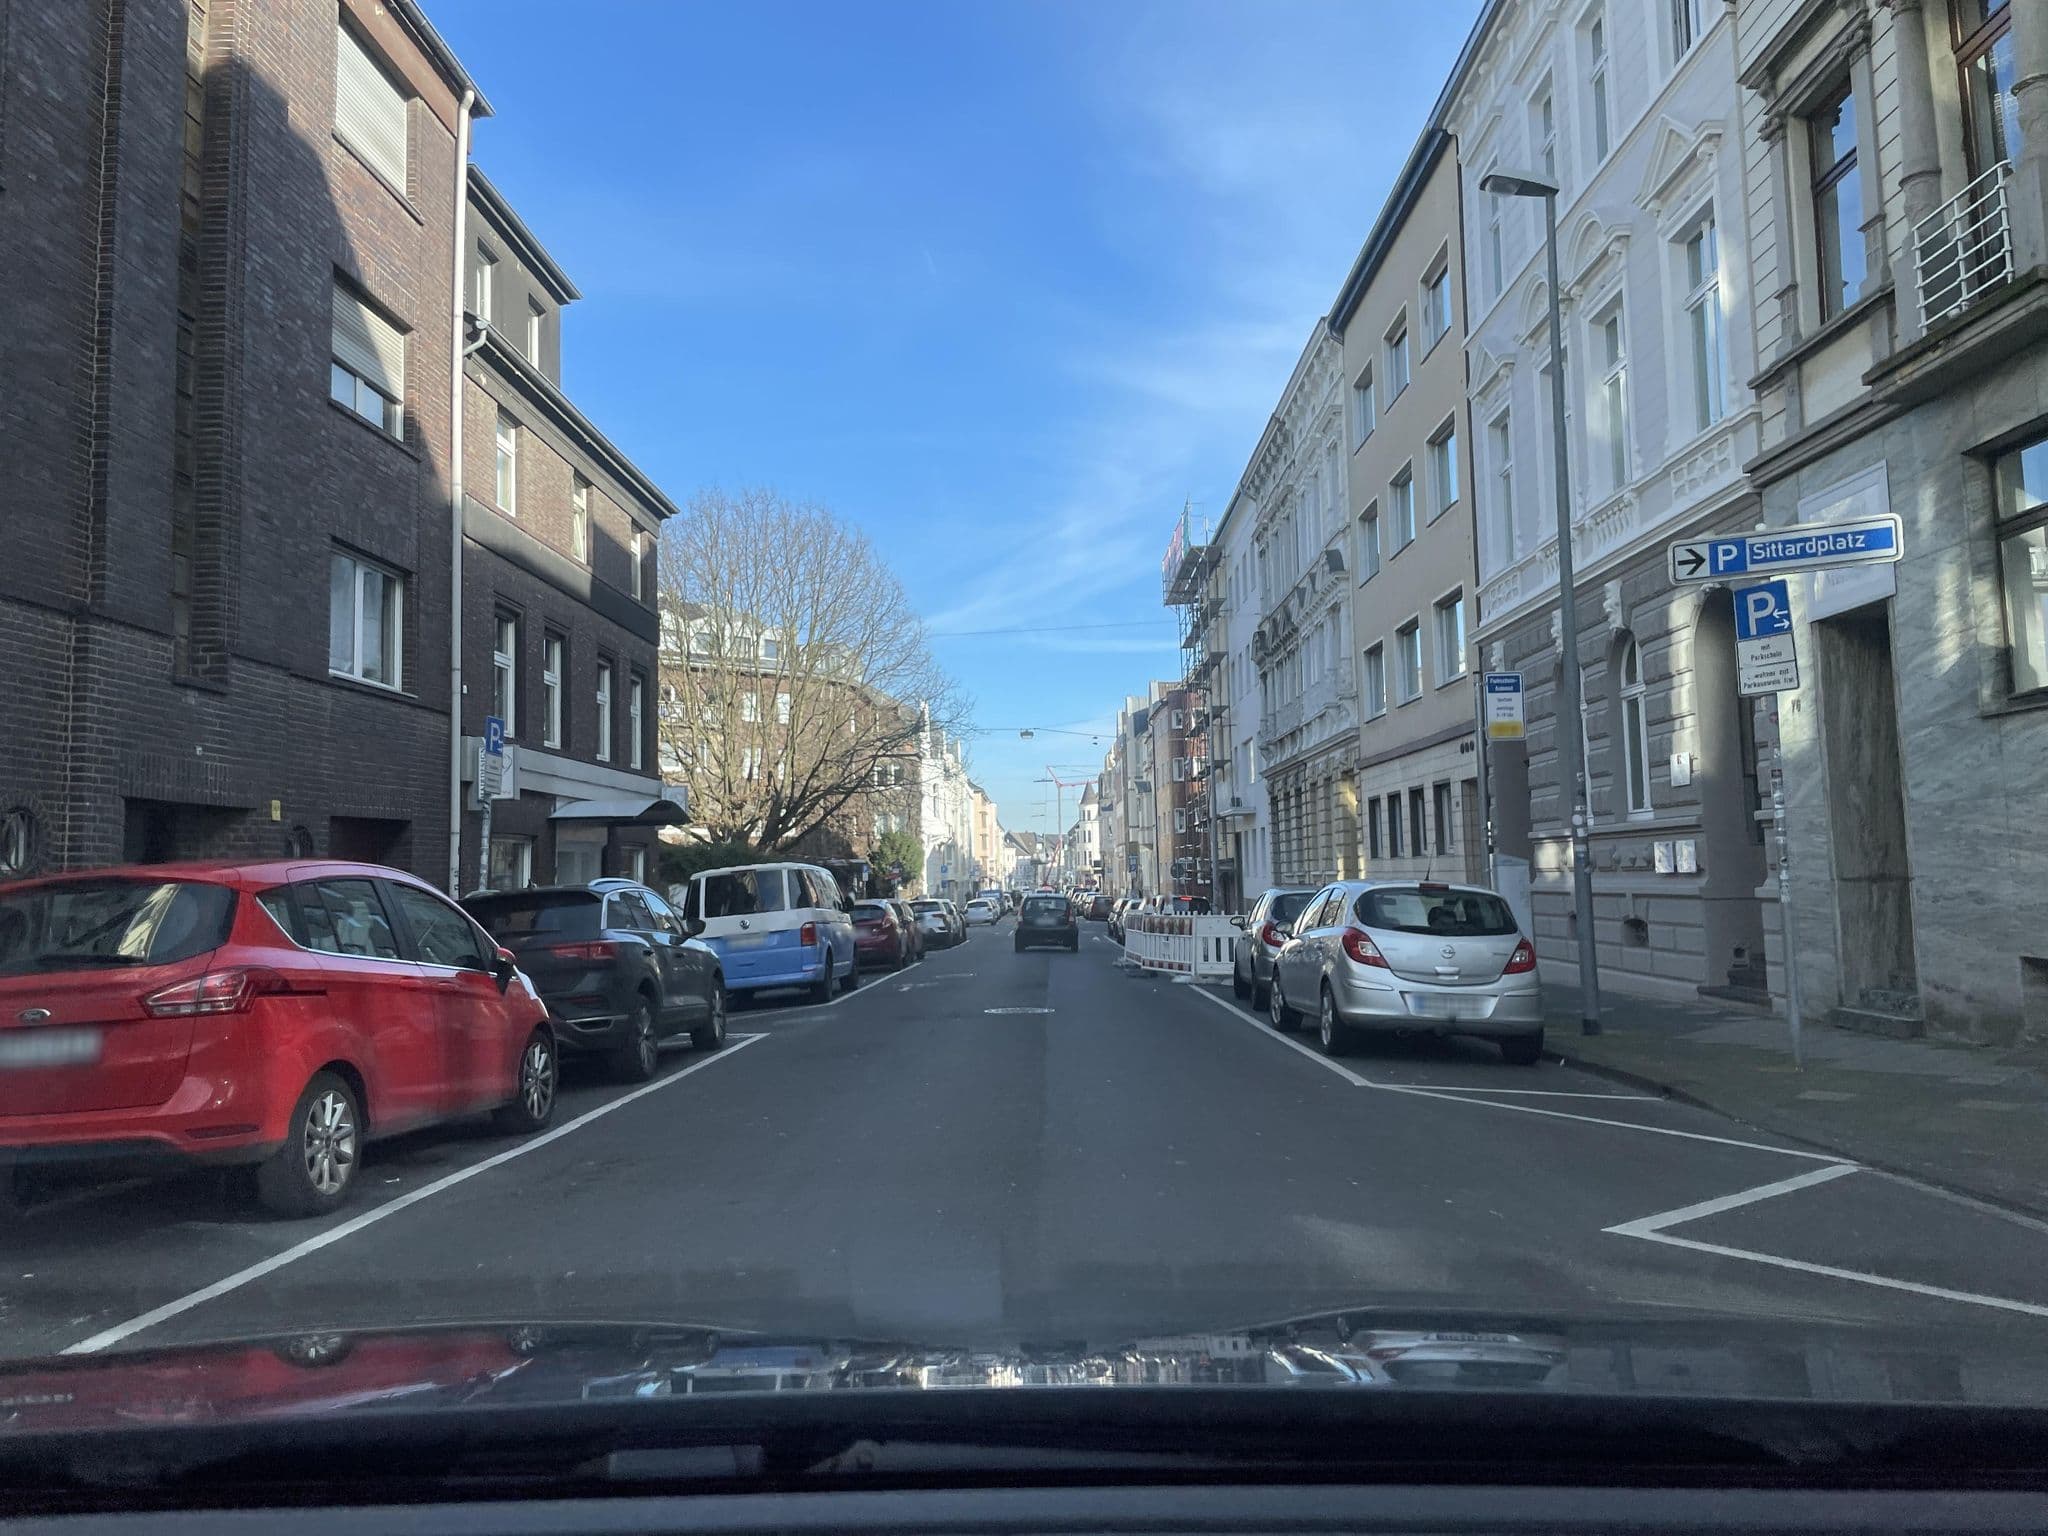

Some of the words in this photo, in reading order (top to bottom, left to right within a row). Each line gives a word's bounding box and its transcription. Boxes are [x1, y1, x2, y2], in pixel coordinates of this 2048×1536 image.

[1717, 544, 1738, 571] P
[1752, 533, 1866, 560] Sittardplatz
[1746, 591, 1776, 636] P
[490, 722, 501, 751] P
